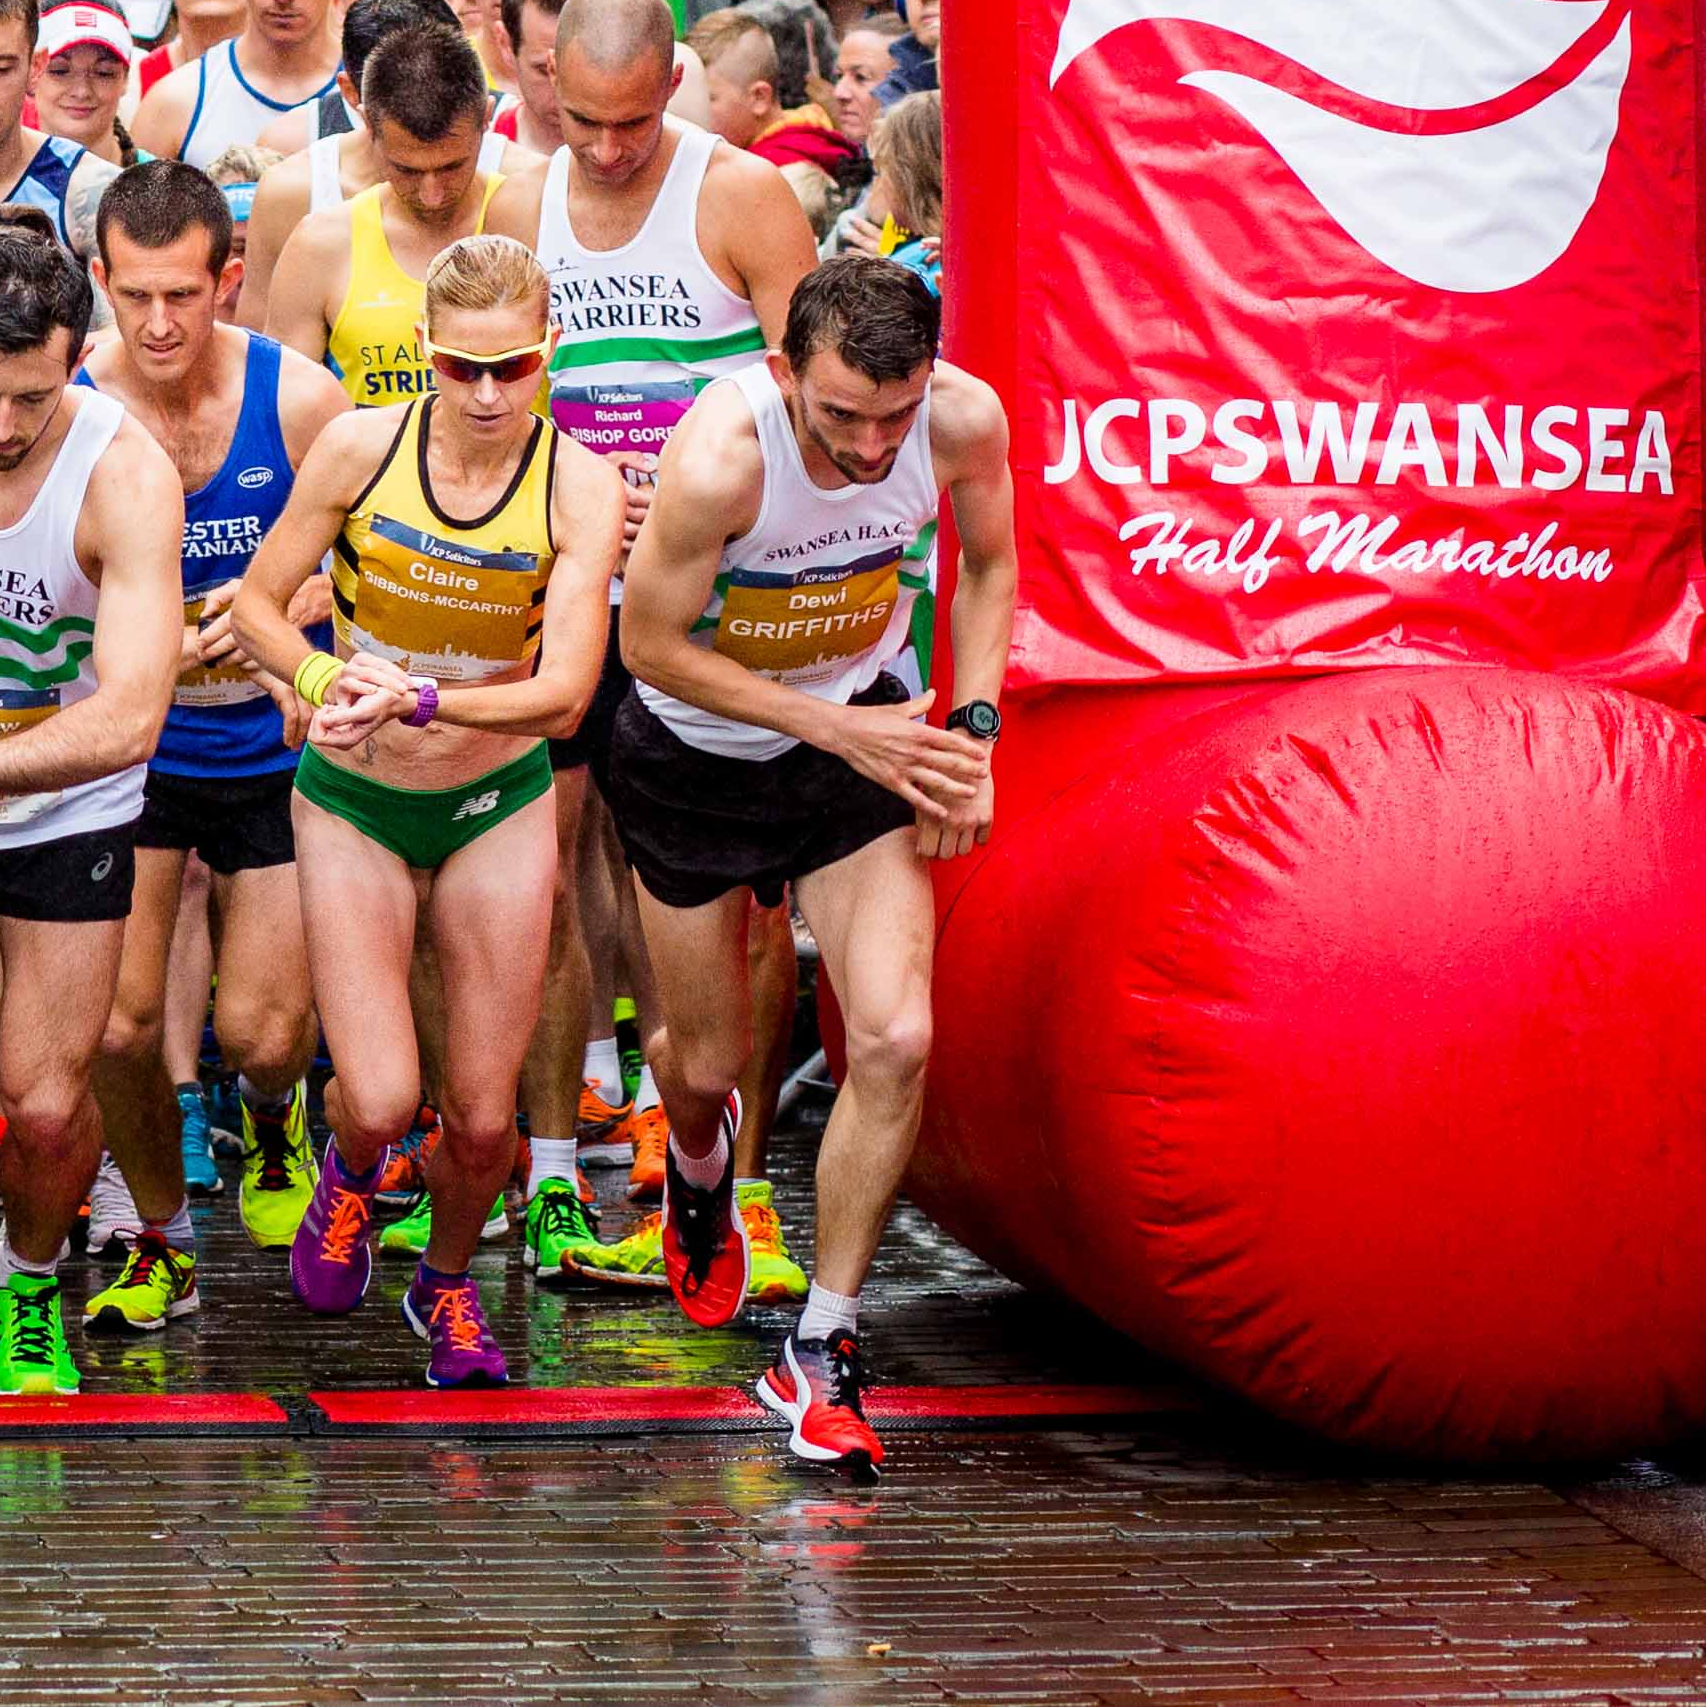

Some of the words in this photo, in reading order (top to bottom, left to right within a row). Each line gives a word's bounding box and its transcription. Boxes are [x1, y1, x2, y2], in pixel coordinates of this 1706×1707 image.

[551, 275, 691, 307] SWANSEA
[361, 344, 385, 366] ST
[595, 409, 642, 422] Richard
[570, 427, 625, 444] BISHOP
[1044, 398, 1675, 495] JCPSWANSEA
[764, 528, 852, 562] SWANSEA
[1119, 510, 1284, 595] Half
[1298, 512, 1614, 583] Marathon
[409, 561, 480, 591] Claire
[364, 570, 524, 615] GIBBONS-MCCARTHY
[788, 586, 847, 610] Dewi
[728, 601, 890, 639] GRIFFITHS
